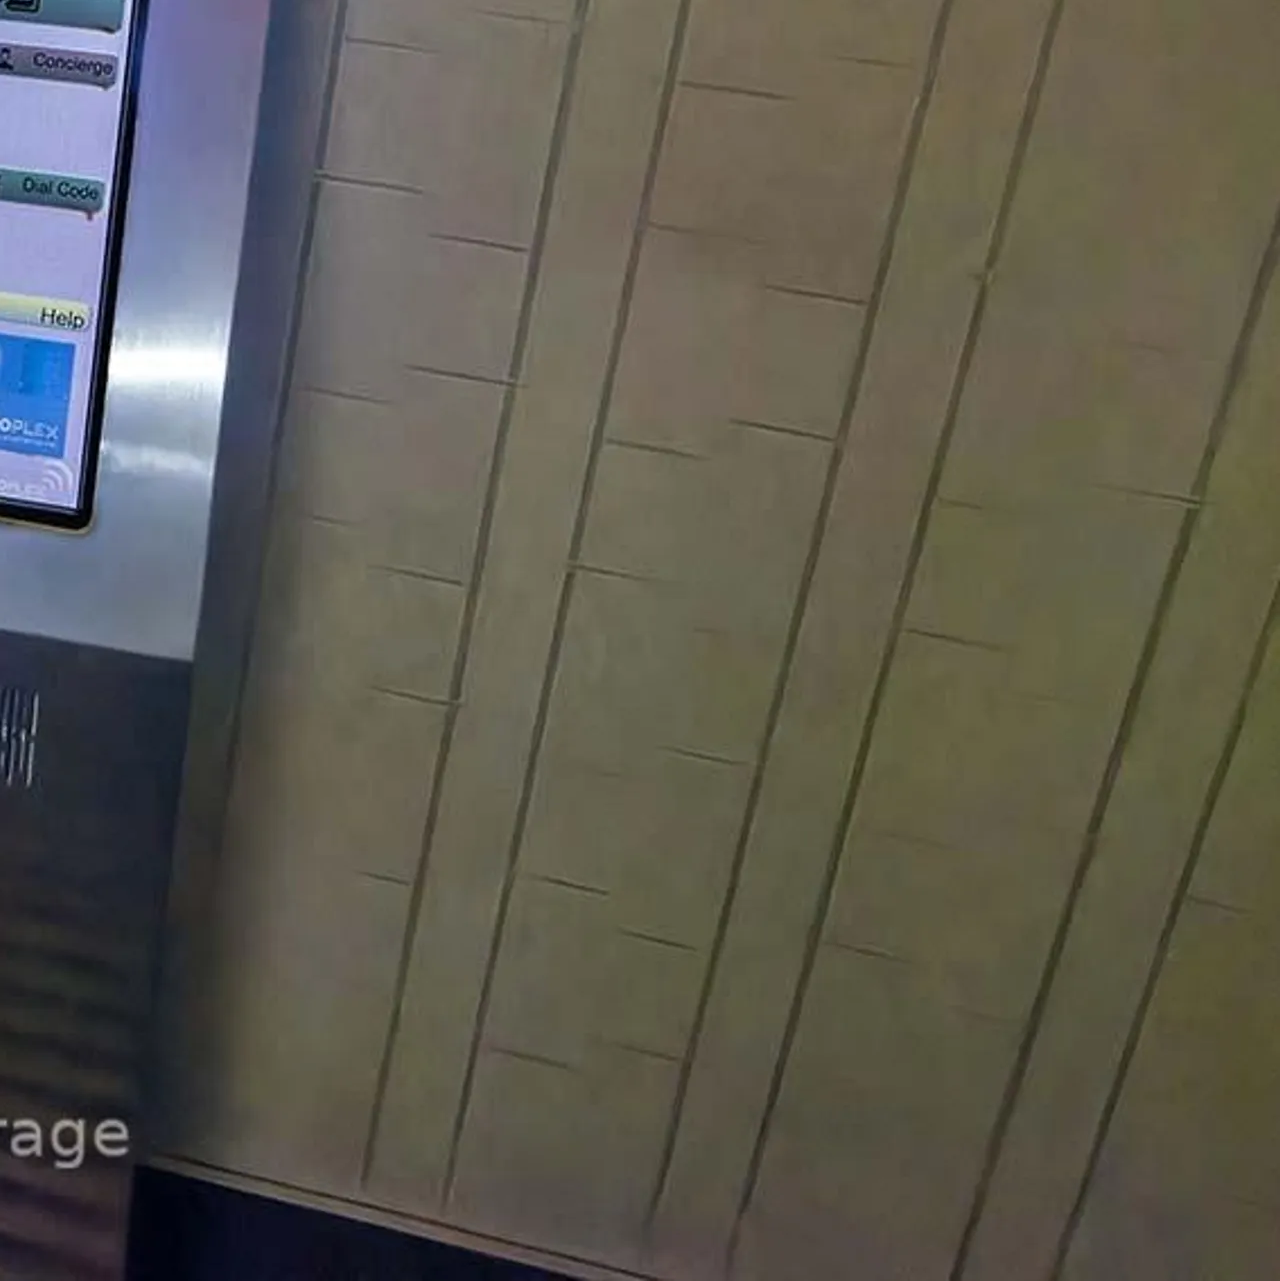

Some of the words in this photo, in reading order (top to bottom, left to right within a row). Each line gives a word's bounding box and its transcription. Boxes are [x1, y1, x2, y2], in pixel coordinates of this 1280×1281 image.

[33, 50, 114, 77] Concierge
[22, 176, 53, 196] Dial
[56, 180, 100, 202] Code
[40, 307, 85, 331] Help
